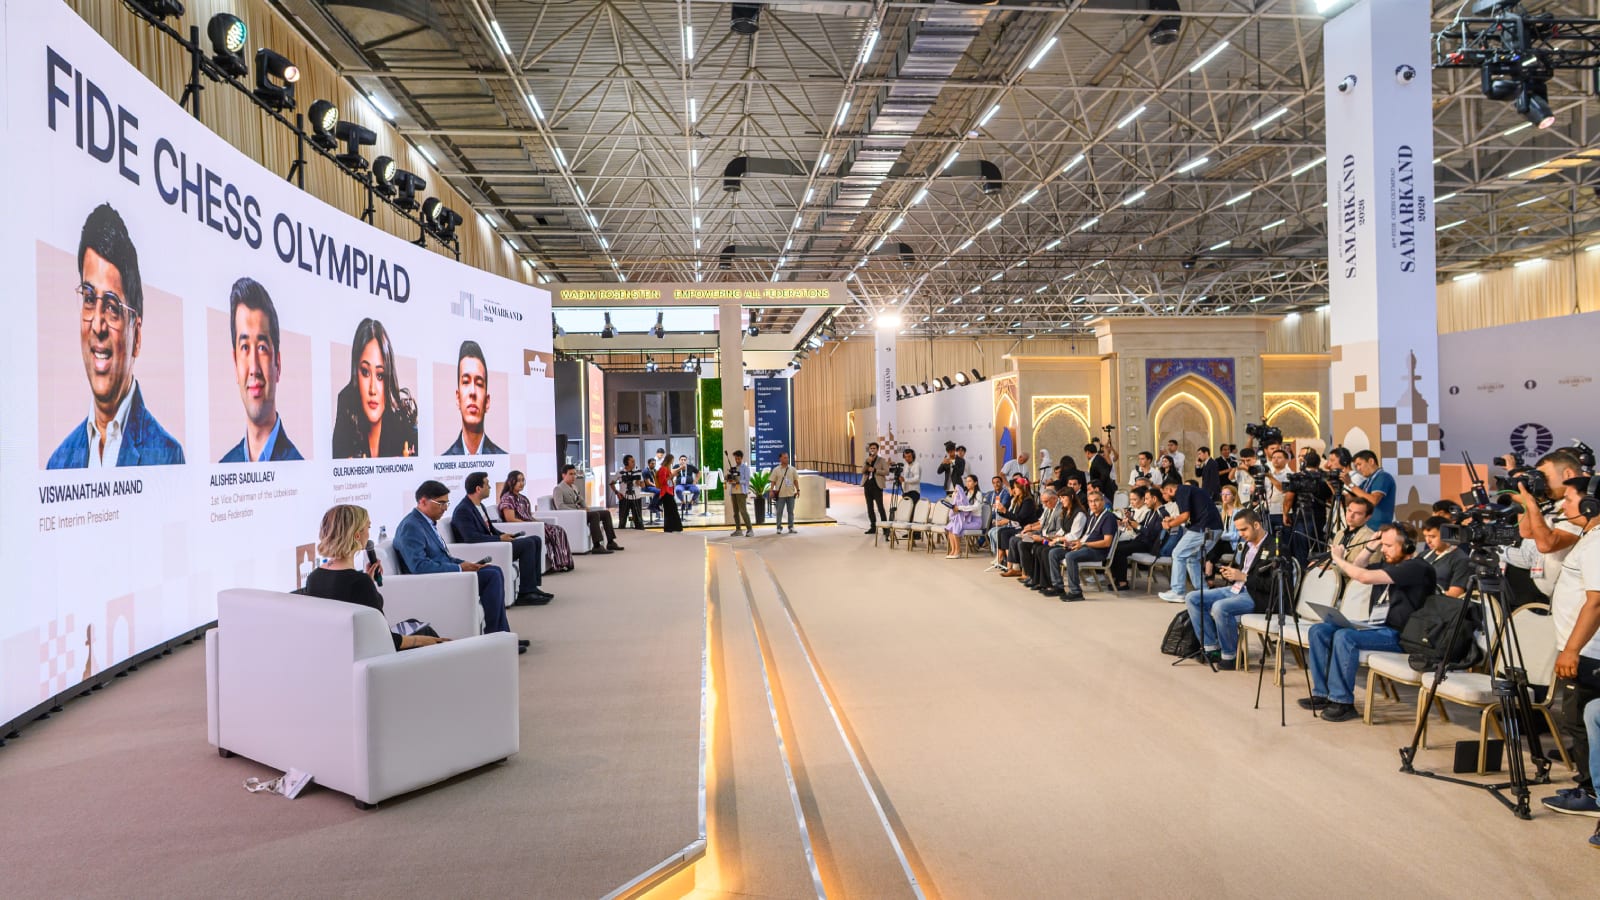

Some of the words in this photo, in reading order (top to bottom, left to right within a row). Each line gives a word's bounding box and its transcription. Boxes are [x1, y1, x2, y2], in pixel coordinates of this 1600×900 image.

[46, 44, 141, 186] FIDE
[153, 137, 263, 250] CHESS
[273, 212, 411, 303] OLYMPIAD
[1343, 154, 1357, 279] SAMARKAND
[1358, 199, 1366, 226] 2026
[1397, 144, 1416, 273] SAMARKAND
[1417, 195, 1426, 222] 2026
[560, 289, 597, 300] WADIM
[674, 289, 742, 299] EMPOWERING
[744, 289, 762, 299] ALL
[763, 288, 830, 299] FEDERATIONS
[483, 304, 523, 321] SAMARKAND
[332, 465, 375, 477] GULRUKHBEGIM
[433, 461, 455, 471] NODIRBEK
[209, 473, 238, 487] ALISHER
[238, 471, 276, 485] SADULLAEV
[38, 483, 111, 504] VISWANATHAN
[112, 479, 143, 497] ANAND
[210, 495, 220, 506] 1st
[220, 494, 232, 504] Vice
[232, 492, 257, 503] Chairman
[257, 490, 263, 500] of
[263, 490, 273, 499] the
[38, 515, 56, 533] FIDE
[58, 512, 86, 529] Interim
[87, 508, 120, 525] President
[210, 511, 227, 523] Chess
[227, 508, 254, 520] Federation
